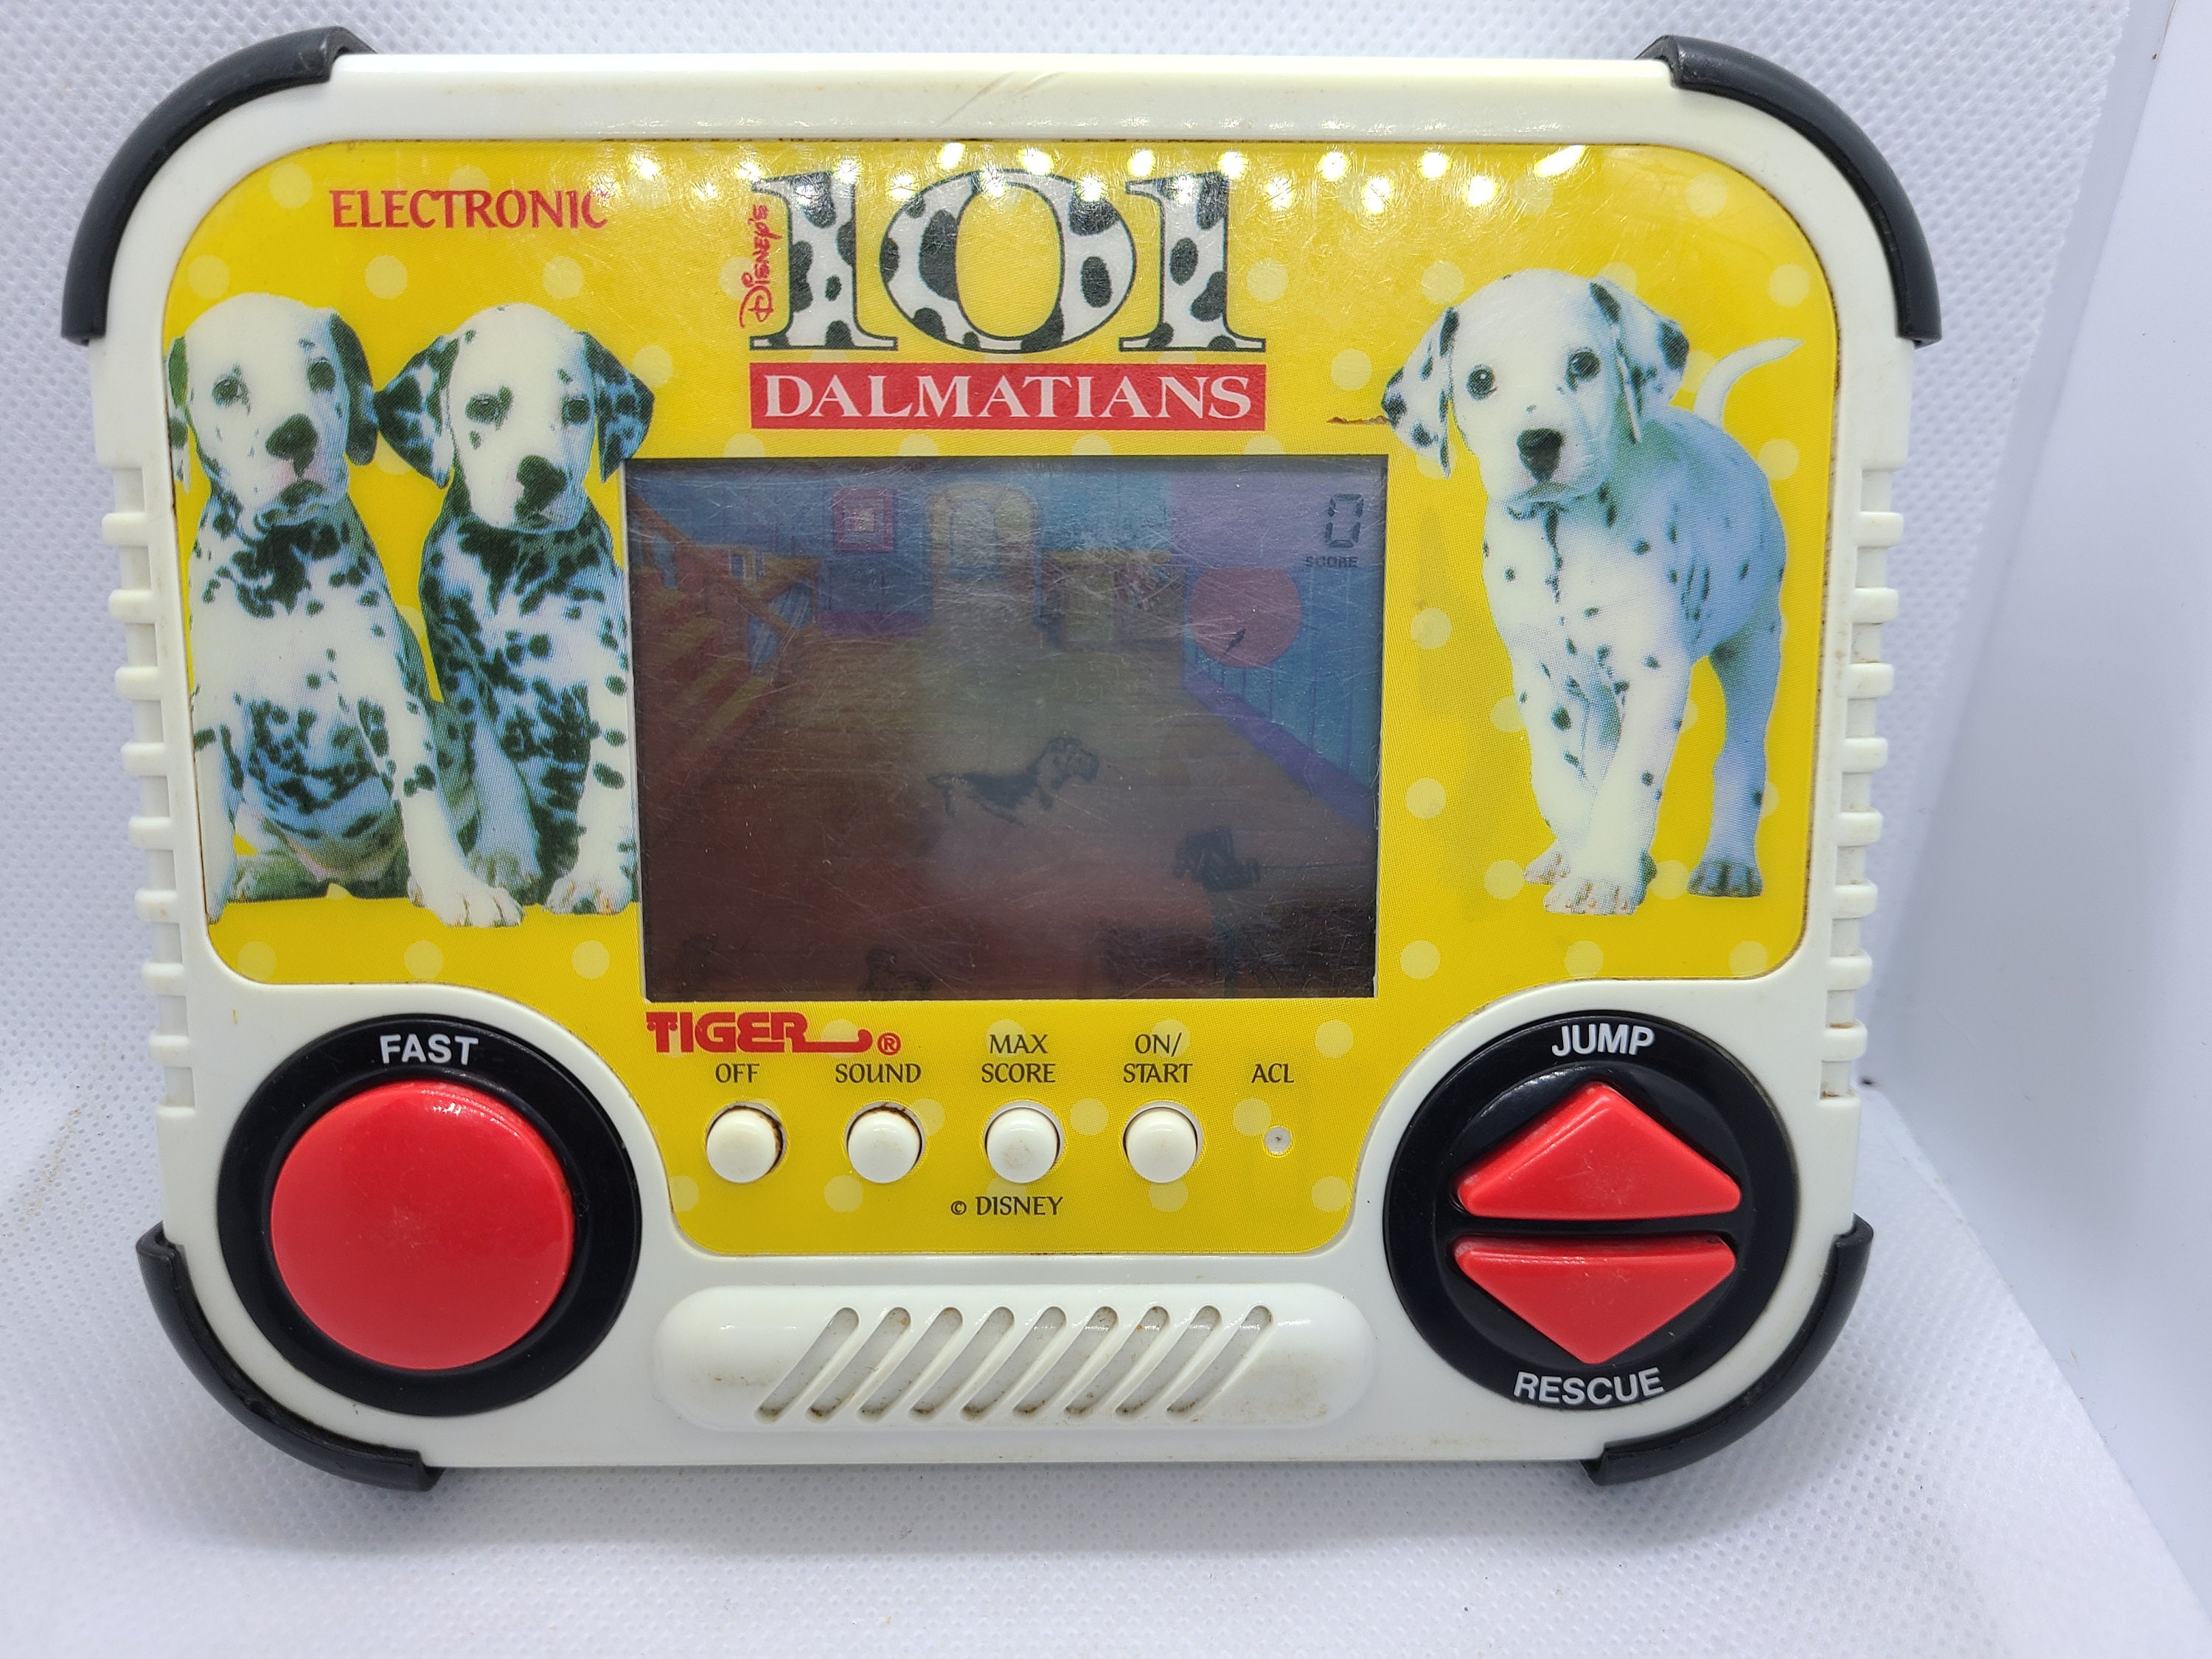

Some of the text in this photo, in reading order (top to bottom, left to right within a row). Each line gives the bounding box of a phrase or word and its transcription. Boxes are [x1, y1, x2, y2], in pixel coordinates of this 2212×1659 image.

[329, 189, 608, 229] ELECTRONIC
[749, 168, 1267, 352] 101
[763, 373, 1252, 420] DALMATIANS
[1325, 493, 1364, 548] 0
[1304, 556, 1358, 568] SCORE
[645, 1011, 873, 1053] TIGER
[989, 1034, 1048, 1054] MAX
[1134, 1032, 1183, 1057] ON/
[1551, 1023, 1656, 1057] JUMP
[379, 1033, 479, 1065] FAST
[714, 1062, 760, 1084] OFF
[835, 1062, 922, 1084] SOUND
[981, 1062, 1056, 1083] SCORE
[1122, 1062, 1193, 1083] START
[1251, 1062, 1295, 1083] ACL
[975, 1195, 1064, 1216] DISNEY
[1513, 1366, 1665, 1406] RESCUE
